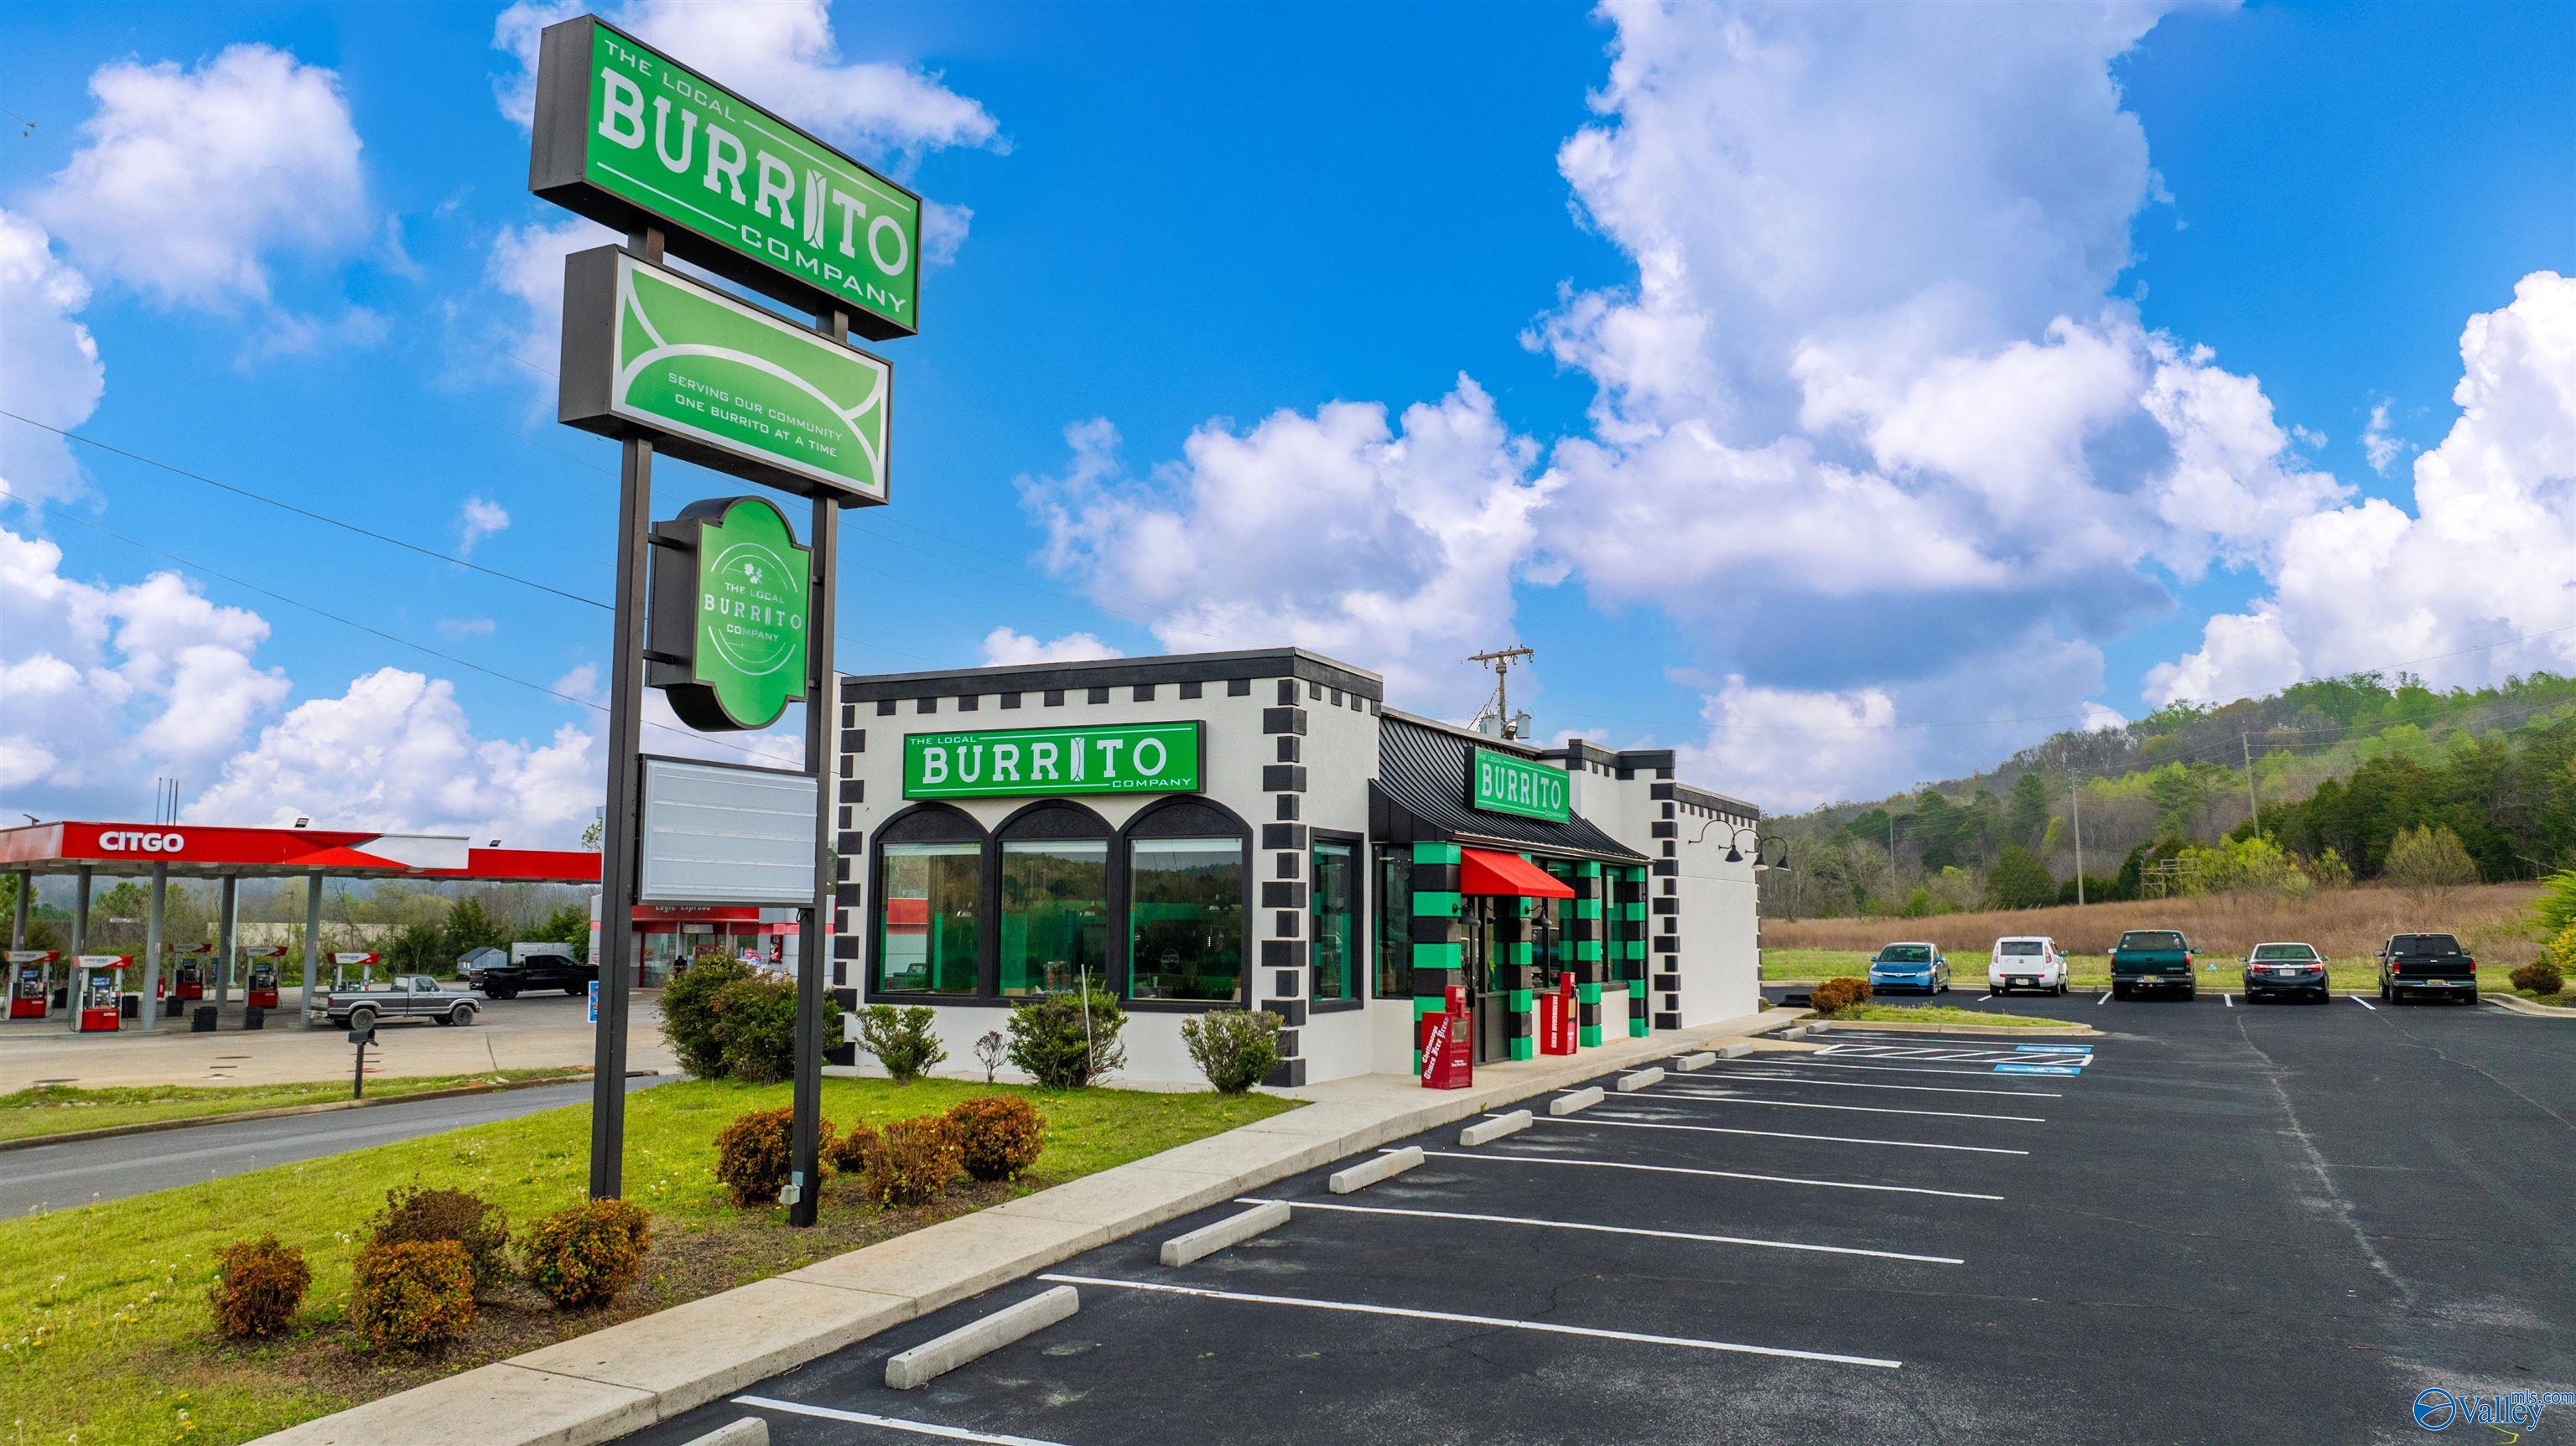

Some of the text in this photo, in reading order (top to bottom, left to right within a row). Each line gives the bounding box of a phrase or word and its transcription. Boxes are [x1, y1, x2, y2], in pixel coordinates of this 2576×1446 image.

[605, 39, 735, 122] THE LOCAL
[598, 66, 909, 277] BURRITO
[741, 224, 906, 314] COMPANY
[668, 372, 843, 442] SERVING OUR COMMUNITY
[675, 394, 838, 457] ONE BURRITO AT A TIME
[704, 593, 802, 630] BURRITO
[724, 582, 785, 604] THE LOCAL
[726, 624, 780, 642] COMPANY
[937, 736, 976, 744] LOCAL
[1488, 755, 1503, 764] LOCAL
[922, 737, 1167, 784] BURRITO
[1112, 778, 1192, 788] COMPANY
[1482, 763, 1561, 810] BURRITO
[1545, 810, 1567, 818] COMPANY
[99, 831, 184, 853] CITGO
[1423, 1056, 1436, 1080] Times
[1431, 1039, 1442, 1057] Free
